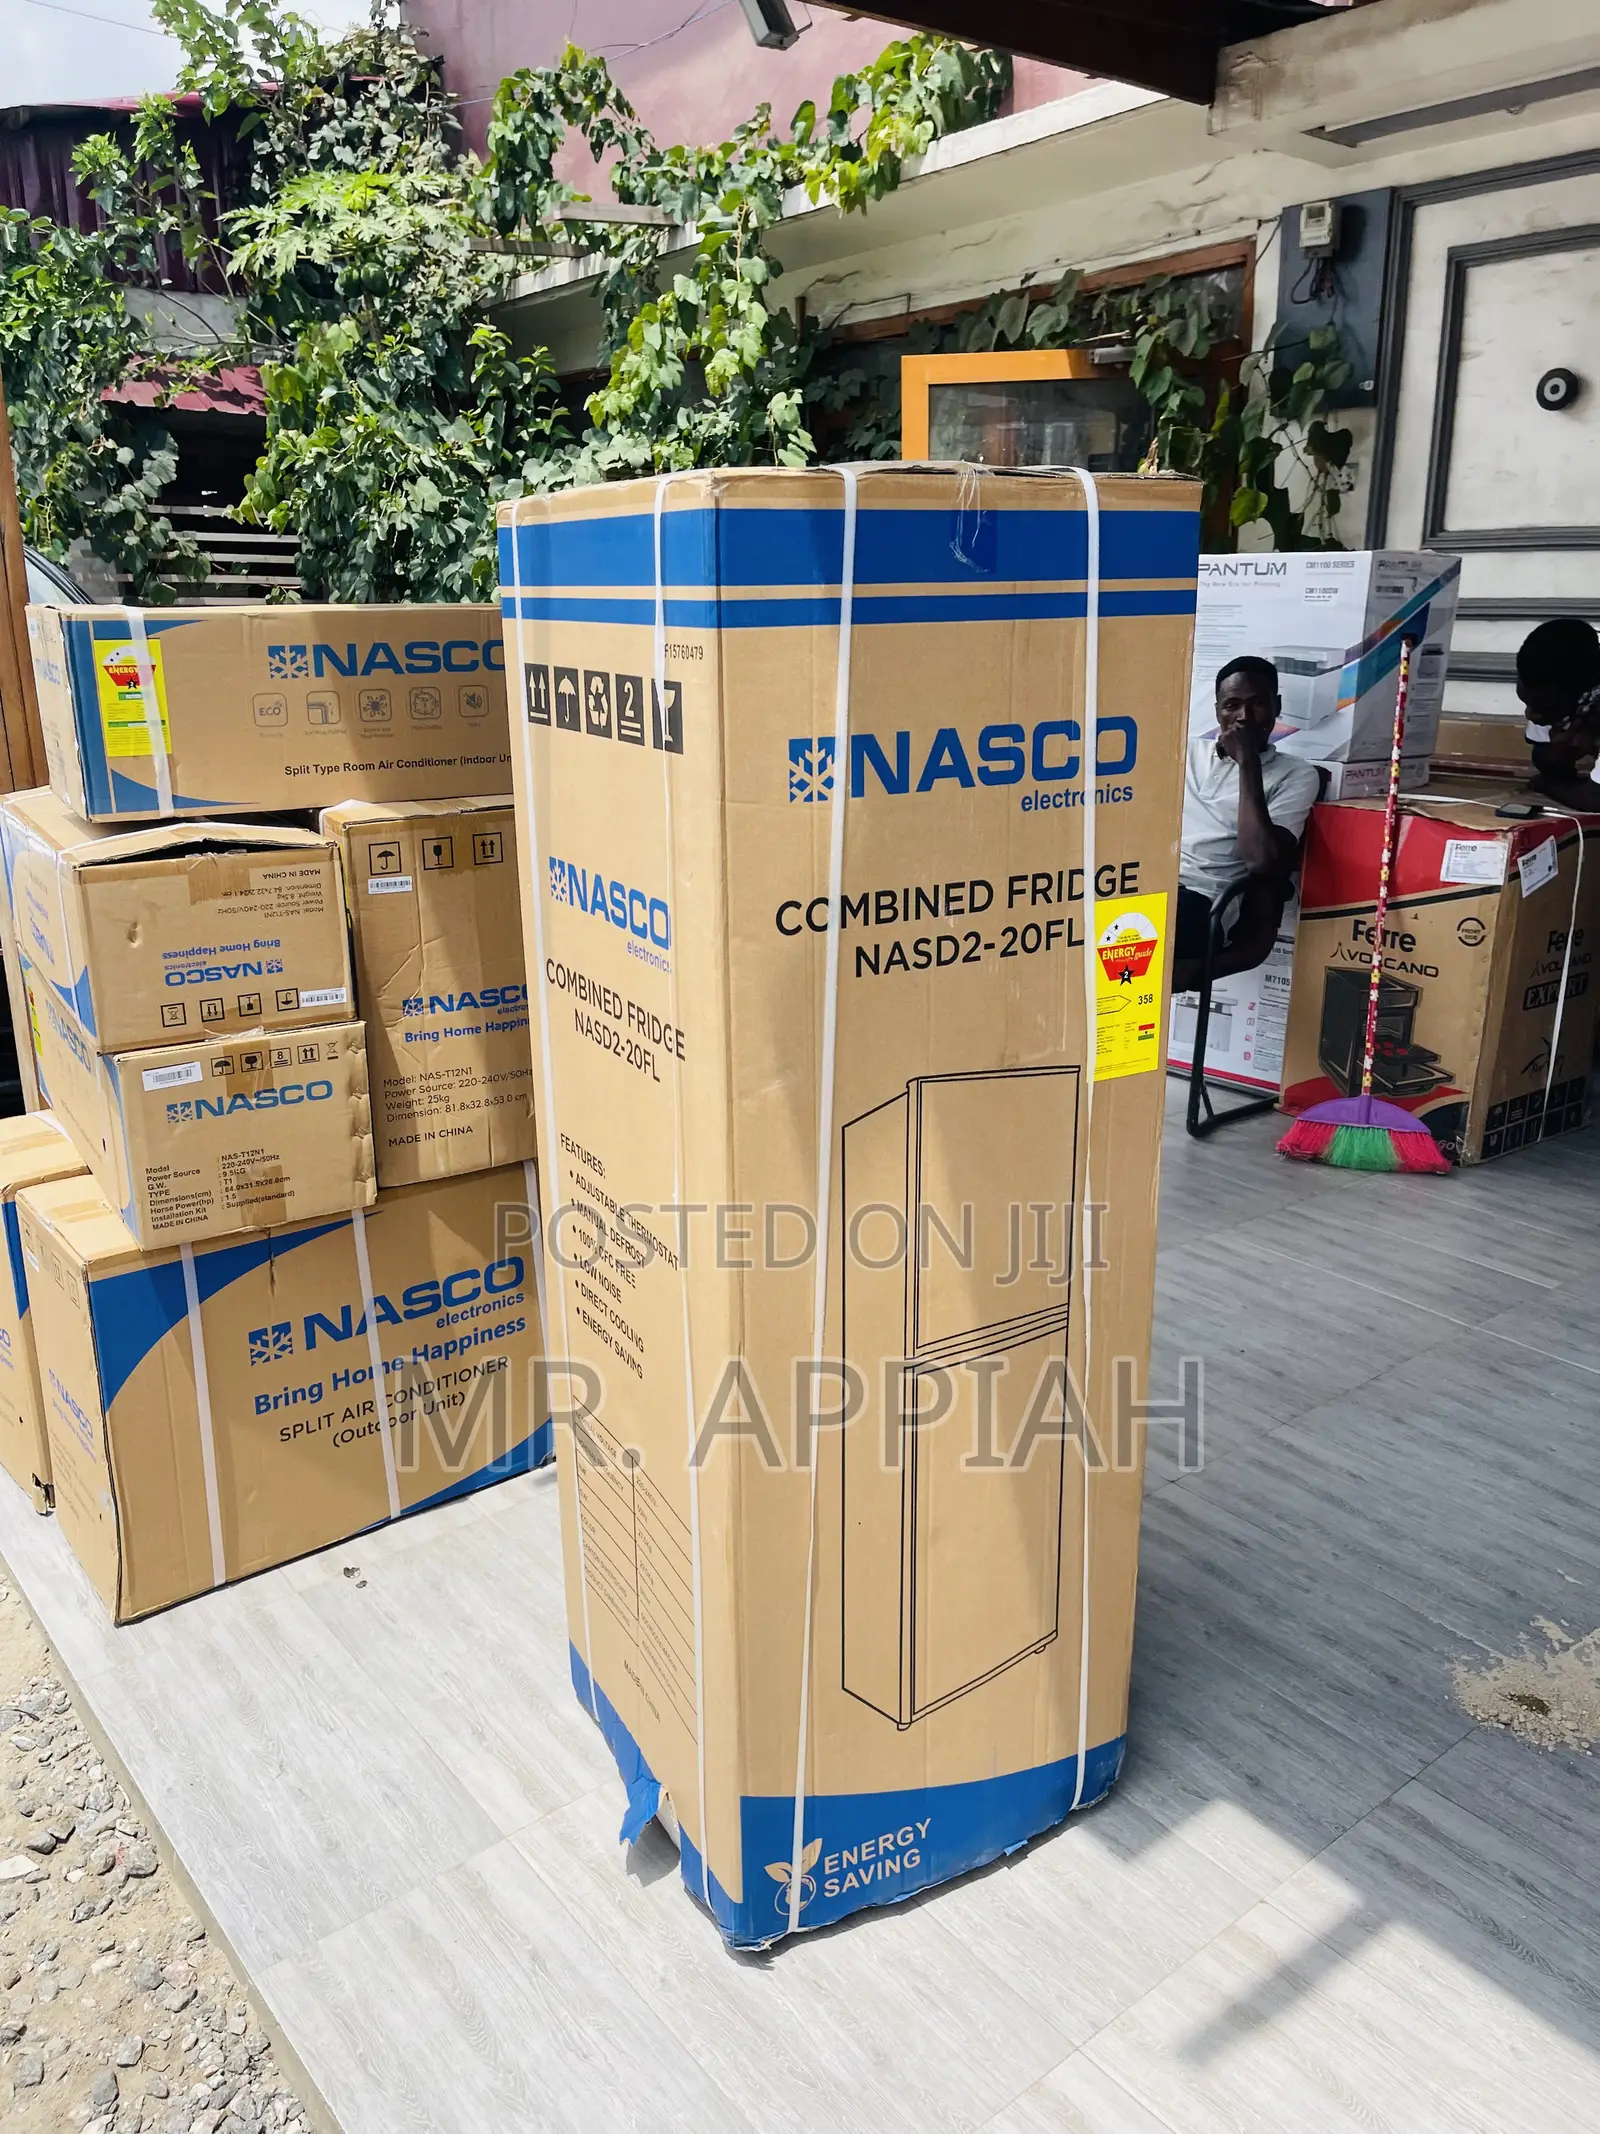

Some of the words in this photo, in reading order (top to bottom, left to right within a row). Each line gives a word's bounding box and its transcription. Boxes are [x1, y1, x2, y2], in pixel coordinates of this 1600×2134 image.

[1198, 562, 1287, 576] PANTUM
[260, 706, 281, 716] ECO
[284, 764, 310, 777] Split
[312, 764, 340, 776] Type
[343, 762, 375, 772] Room
[378, 760, 394, 770] Air
[396, 757, 458, 769] Conditioner
[460, 755, 496, 767] (Indoor
[850, 715, 1138, 798] NASCO
[262, 871, 287, 880] CHINA
[288, 870, 297, 878] IN
[299, 869, 321, 878] MADE
[568, 863, 672, 950] NASCO
[776, 879, 994, 936] COMBINED
[1007, 861, 1140, 909] FRIDGE
[162, 946, 217, 960] Happiness
[219, 942, 250, 953] Home
[253, 939, 281, 953] Bring
[627, 941, 672, 974] electronics
[855, 917, 1084, 978] NASD2-20FL
[1102, 946, 1136, 962] ENERGY
[164, 960, 207, 970] electronics
[164, 961, 262, 987] NASCO
[1347, 949, 1439, 978] VOCANO
[429, 984, 528, 1014] NASC
[1138, 994, 1154, 1006] 358
[1526, 976, 1586, 1008] EXPRT
[546, 958, 622, 1020] COMBINED
[628, 1000, 686, 1062] FRIDGE
[405, 1030, 439, 1044] Bring
[444, 1026, 482, 1038] Home
[486, 1017, 530, 1033] Happin
[574, 1008, 660, 1084] NASD2-20FL
[384, 1075, 416, 1088] Model:
[420, 1067, 472, 1082] NAS-T12N1
[196, 1080, 333, 1120] NASCO
[384, 1088, 416, 1100] Power
[419, 1083, 456, 1094] Source:
[386, 1098, 424, 1111] Weight:
[428, 1095, 450, 1106] 25kg
[386, 1107, 442, 1123] Dimension:
[514, 1093, 528, 1102] cm
[388, 1134, 422, 1148] MADE
[424, 1130, 436, 1141] IN
[438, 1125, 474, 1138] CHINA
[146, 1165, 170, 1174] Model
[222, 1149, 264, 1162] NAS-T12N1
[560, 1133, 606, 1179] FEATURES:
[147, 1173, 172, 1182] Power
[173, 1169, 200, 1179] Source
[148, 1189, 170, 1198] TYPE
[224, 1178, 233, 1186] T1
[150, 1206, 174, 1215] Horse
[576, 1173, 625, 1224] ADJUSTABLE
[151, 1210, 194, 1222] Installation
[195, 1207, 207, 1216] Kit
[152, 1221, 176, 1230] MADE
[184, 1214, 208, 1224] CHINA
[610, 1228, 646, 1270] DEFROST
[580, 1255, 597, 1282] LOW
[599, 1270, 622, 1304] NOISE
[304, 1256, 524, 1350] NASCO
[436, 1292, 524, 1329] electronics
[581, 1283, 608, 1314] DIRECT
[609, 1311, 644, 1353] COOLING
[582, 1310, 612, 1351] ENERGY
[614, 1340, 643, 1380] SAVING
[254, 1381, 324, 1416] Bring
[411, 1317, 527, 1365] Happiness
[423, 1390, 466, 1416] Unit)
[279, 1412, 335, 1442] SPLIT
[341, 1400, 375, 1422] AIR
[824, 1818, 932, 1875] ENERGY
[824, 1848, 921, 1898] SAVING
